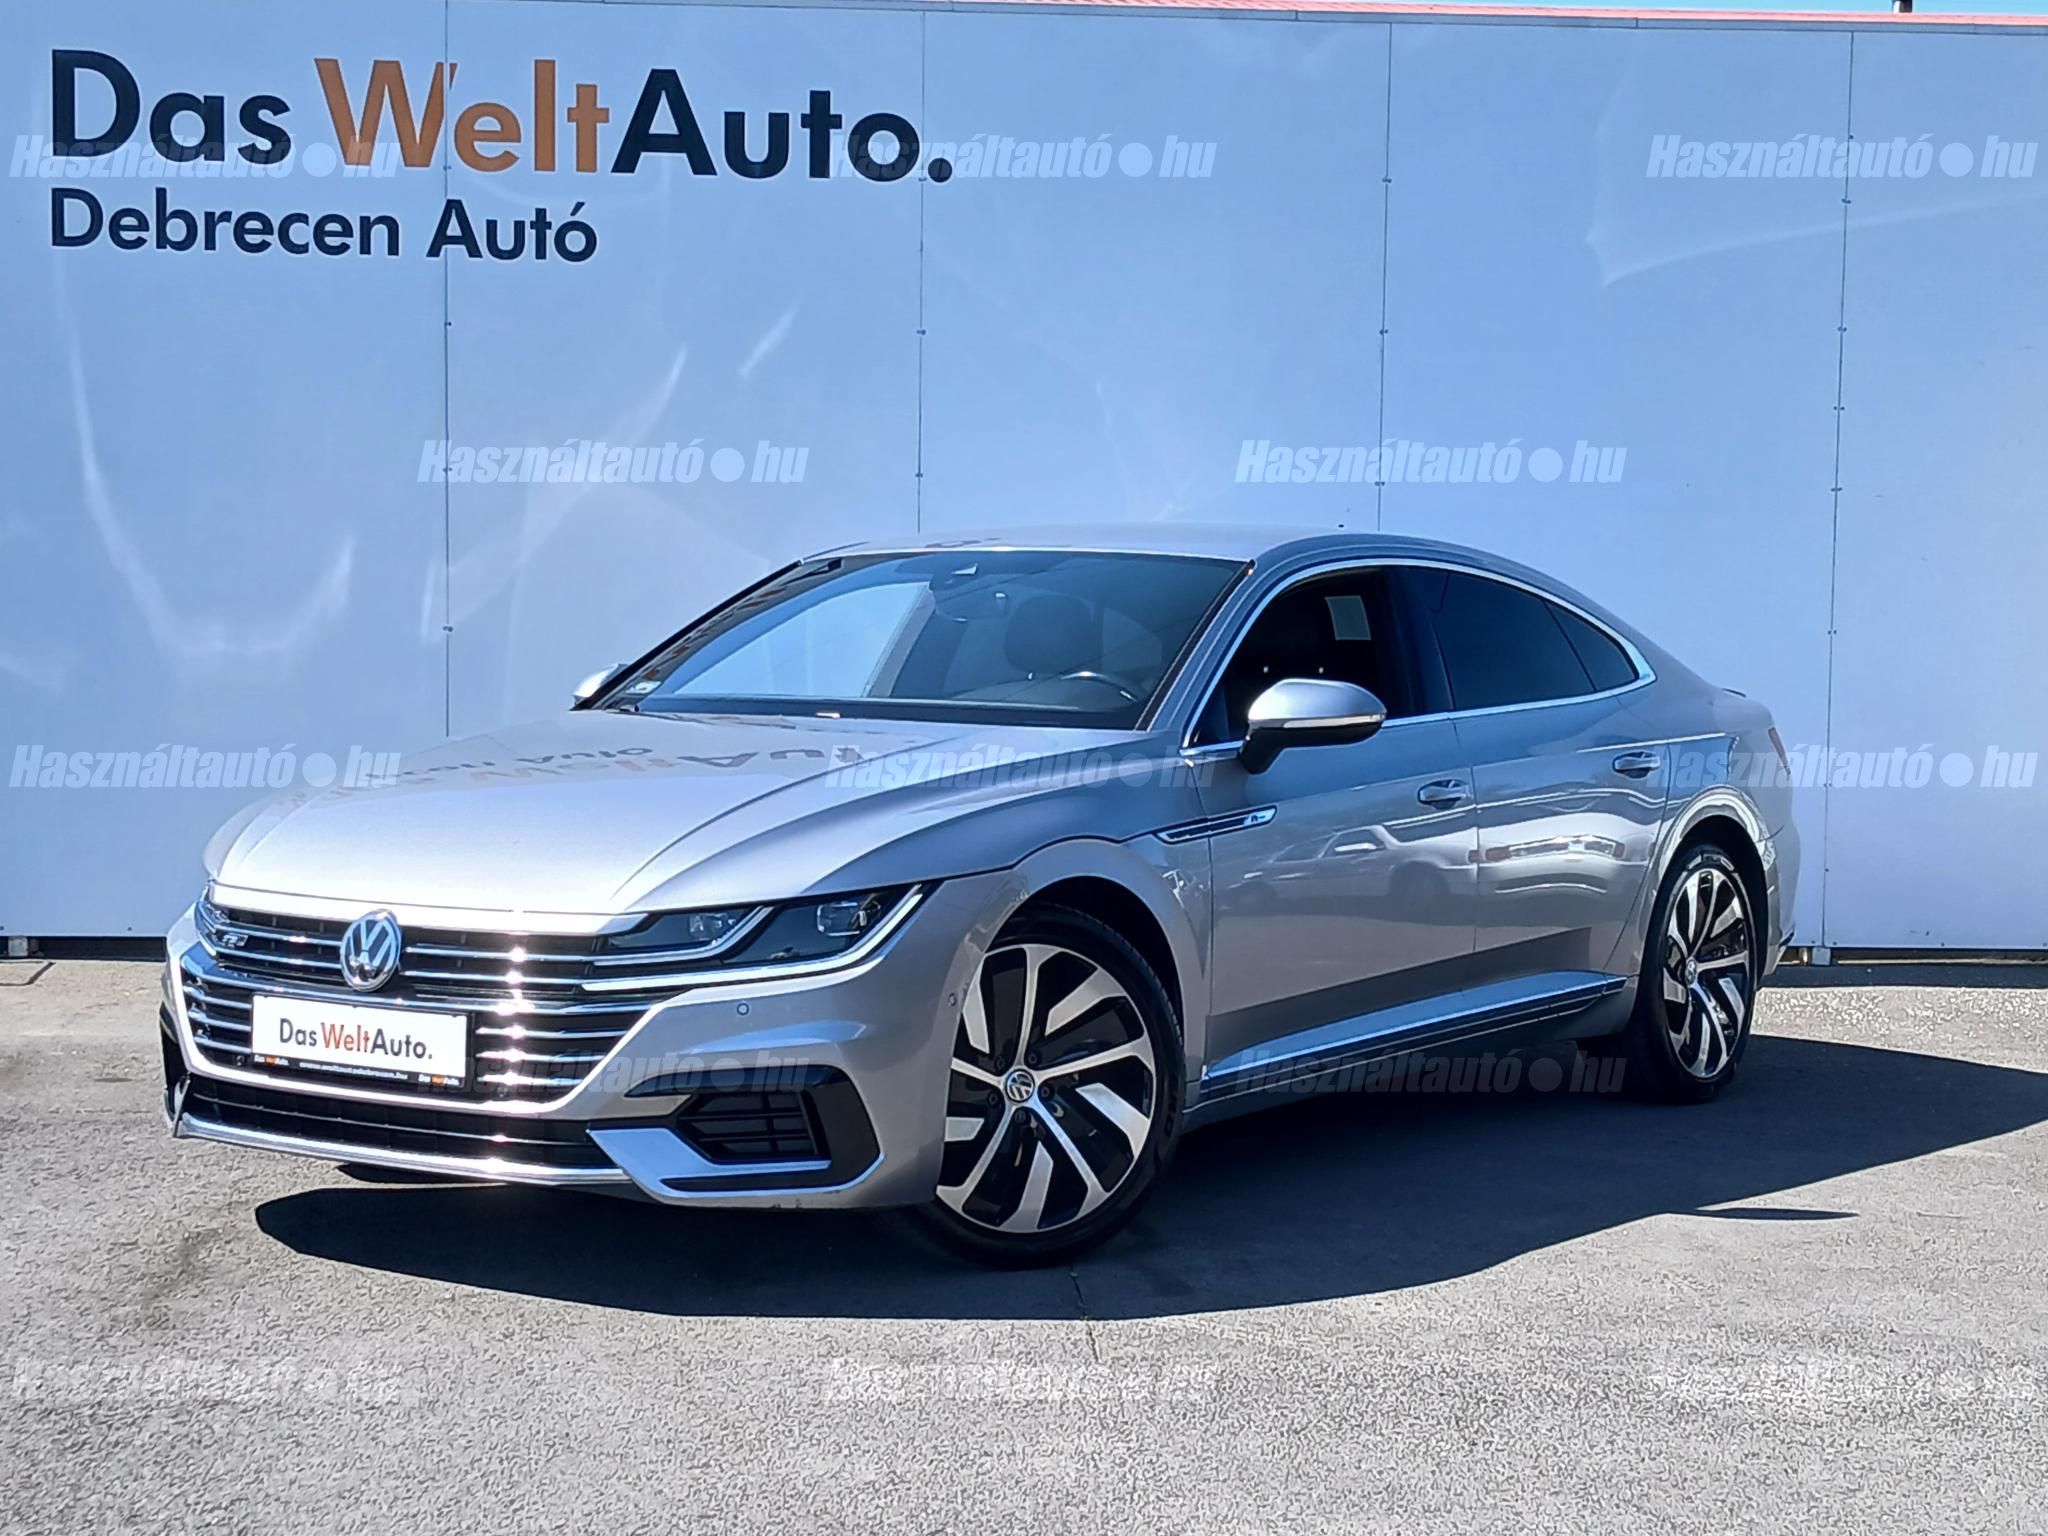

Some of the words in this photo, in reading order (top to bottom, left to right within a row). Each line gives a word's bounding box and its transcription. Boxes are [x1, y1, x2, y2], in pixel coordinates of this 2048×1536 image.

[51, 48, 292, 165] Das
[314, 59, 953, 182] WeltAuto.
[51, 187, 400, 256] Debrecen
[426, 199, 598, 262] Autó
[279, 1017, 318, 1047] Das
[320, 1022, 433, 1060] WeltAuto.
